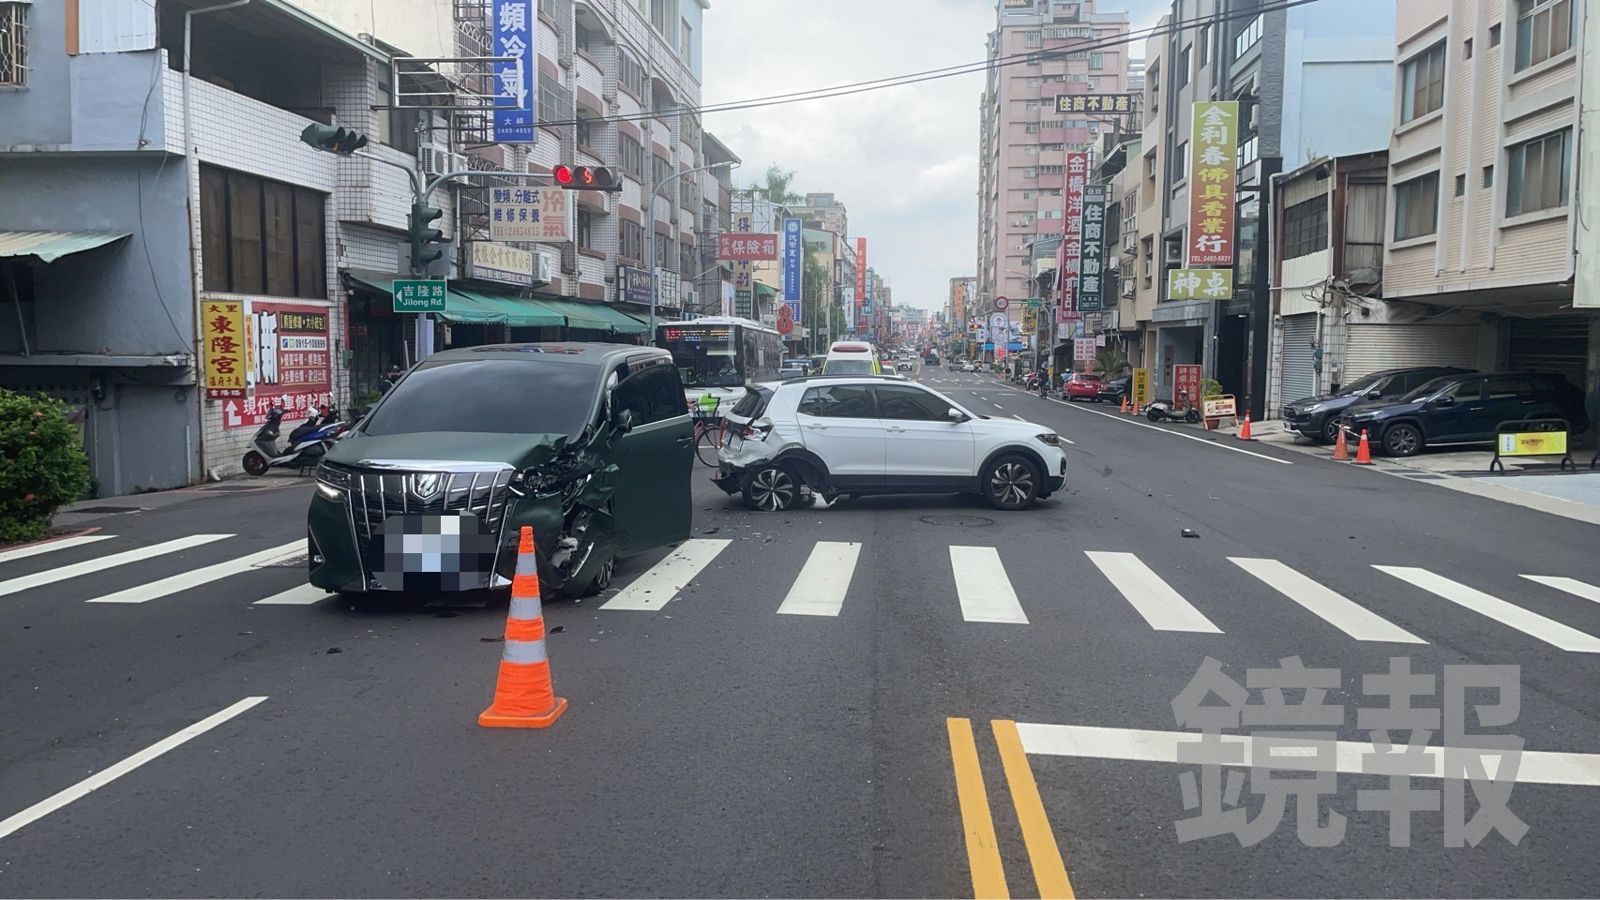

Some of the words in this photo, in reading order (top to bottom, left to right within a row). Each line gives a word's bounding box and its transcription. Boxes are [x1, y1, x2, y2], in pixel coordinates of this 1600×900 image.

[1059, 96, 1129, 112] 住商不動產
[1195, 106, 1232, 253] 金利春佛具香業行
[493, 208, 540, 223] 維修保養
[542, 190, 566, 237] 冷氣
[731, 239, 774, 256] 保險箱
[1082, 204, 1103, 293] 住商不動產
[403, 285, 443, 297] 吉隆路
[1173, 271, 1229, 298] 神桌
[209, 304, 238, 312] 大里
[403, 298, 429, 308] Jilong
[210, 315, 241, 374] 東隆宮
[210, 389, 241, 397] 吉隆路
